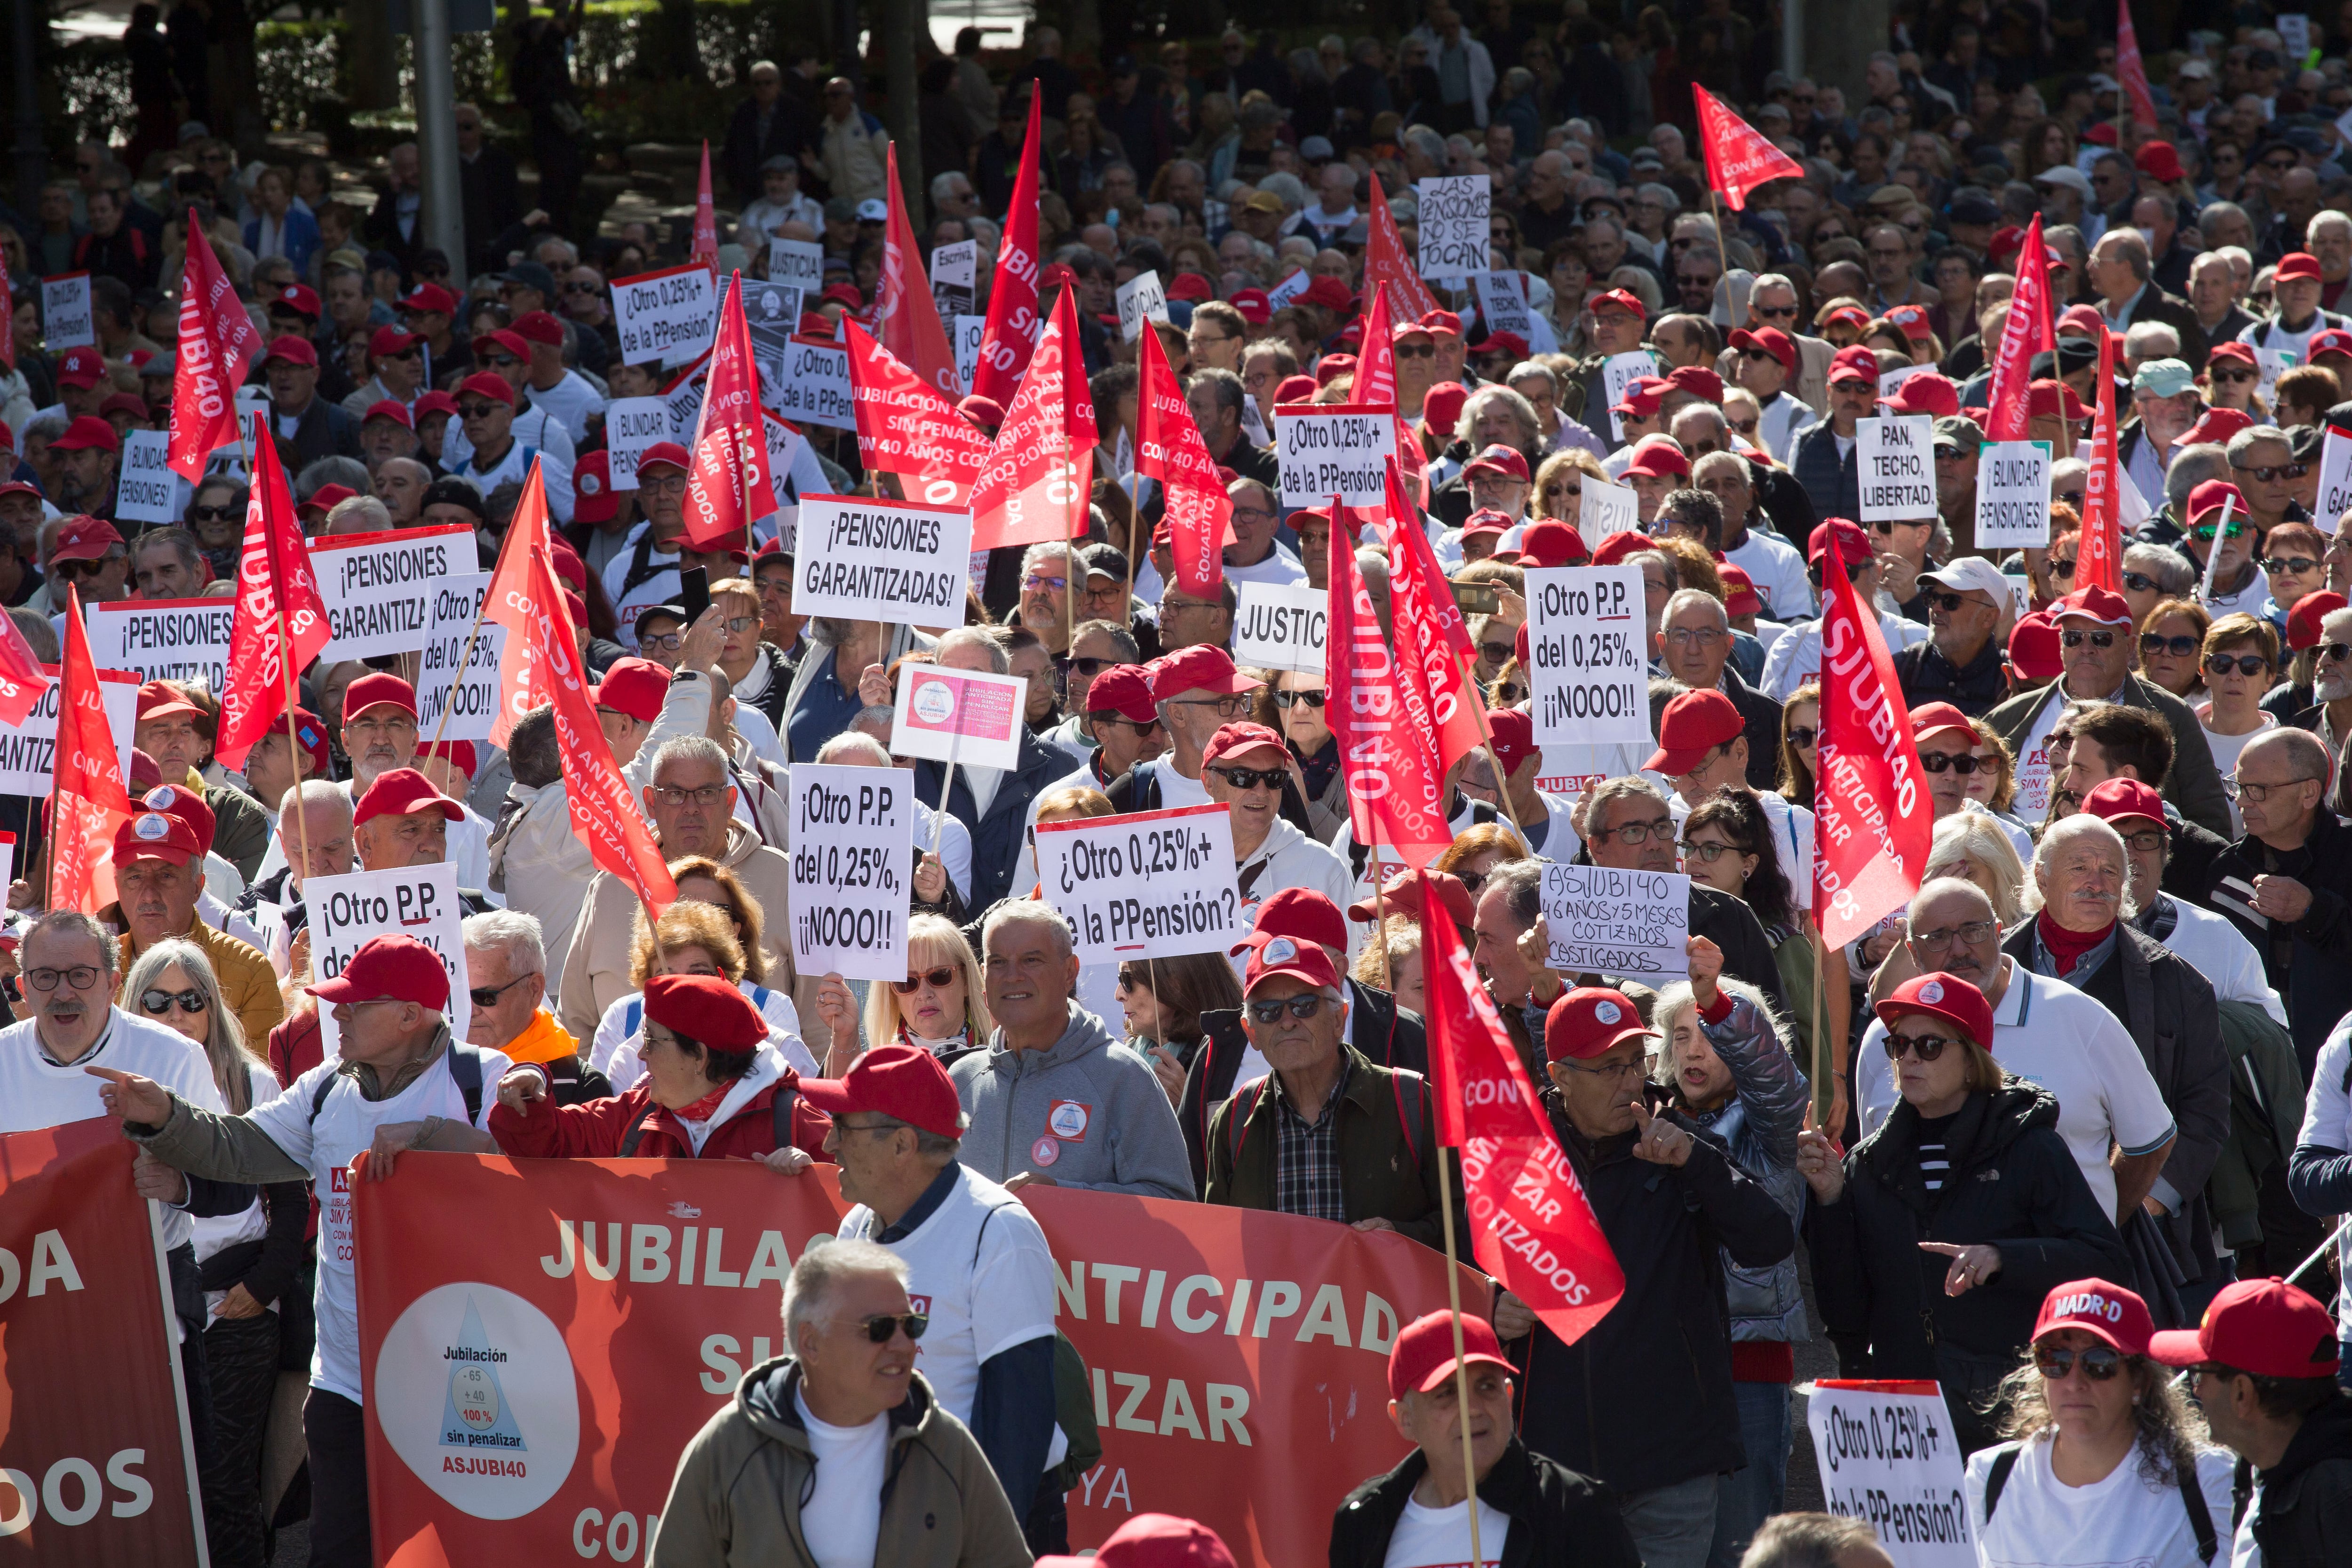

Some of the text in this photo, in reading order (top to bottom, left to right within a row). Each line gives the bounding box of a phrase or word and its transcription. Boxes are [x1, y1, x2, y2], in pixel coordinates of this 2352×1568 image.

[1430, 176, 1474, 196] LAS
[1420, 191, 1489, 223] PENSIONES
[1421, 220, 1479, 245] NO SE
[1420, 238, 1488, 275] TOCAN
[626, 287, 658, 320] ¿Otro
[660, 276, 702, 309] 0,25%+
[622, 327, 637, 352] de
[639, 326, 652, 349] la
[794, 349, 833, 377] ¿Otro
[783, 383, 800, 407] de
[803, 385, 815, 410] la
[853, 386, 950, 415] JUBILACIÓN
[620, 412, 664, 437] BLINDAR
[887, 415, 916, 433] SIN
[1289, 417, 1381, 456] ¿Otro 0,25%+
[1881, 425, 1913, 448] PAN,
[857, 436, 955, 463] ON 40 AÑOS
[1141, 441, 1169, 464] CON
[1172, 451, 1193, 469] 40
[1284, 468, 1301, 493] de
[1304, 465, 1316, 493] la
[1873, 454, 1924, 479] TECHO,
[1993, 460, 2040, 489] BLINDAR
[120, 479, 169, 507] PENSIONES!
[1863, 485, 1935, 508] LIBERTAD.
[1979, 501, 2044, 530] PENSIONES!
[827, 510, 941, 555] ¡PENSIONES
[341, 544, 447, 598] ¡PENSIONES
[806, 559, 955, 608] GARANTIZADAS!
[432, 588, 469, 629] ¡Otro
[1539, 581, 1630, 625] ¡Otro P.P.
[122, 611, 232, 658] ¡PENSIONES
[1241, 604, 1326, 649] JUSTIC
[424, 638, 445, 670] del
[1536, 631, 1639, 674] del 0,25%,
[965, 692, 1012, 703] ANTICIPADA
[965, 701, 1009, 712] PENALIZAR
[1544, 684, 1636, 728] ¡¡NOOO!!
[1821, 588, 1916, 819] ASJUBI40
[2021, 778, 2041, 790] SIN
[801, 782, 895, 833] ¡Otro P.P.
[1820, 744, 1904, 875] ANTICIPADA
[567, 794, 652, 903] COTIZADOS
[1060, 827, 1213, 894] ¿Otro 0,25%+
[795, 845, 899, 894] del 0,25%,
[322, 883, 442, 937] ¡Otro P.P.
[1083, 904, 1103, 945] la
[1111, 887, 1234, 942] PPensión?
[798, 906, 890, 955] ¡¡NOOO!!
[1465, 1078, 1517, 1107] CON
[333, 1230, 347, 1241] CON
[540, 1219, 835, 1289] JUBILA
[444, 1345, 508, 1364] Jubilación
[472, 1389, 485, 1402] 40
[463, 1408, 481, 1423] 100
[446, 1431, 521, 1449] sin penalizar
[1826, 1405, 1939, 1473] ¿Otro 0,25%+
[443, 1456, 526, 1479] ASJUBI40
